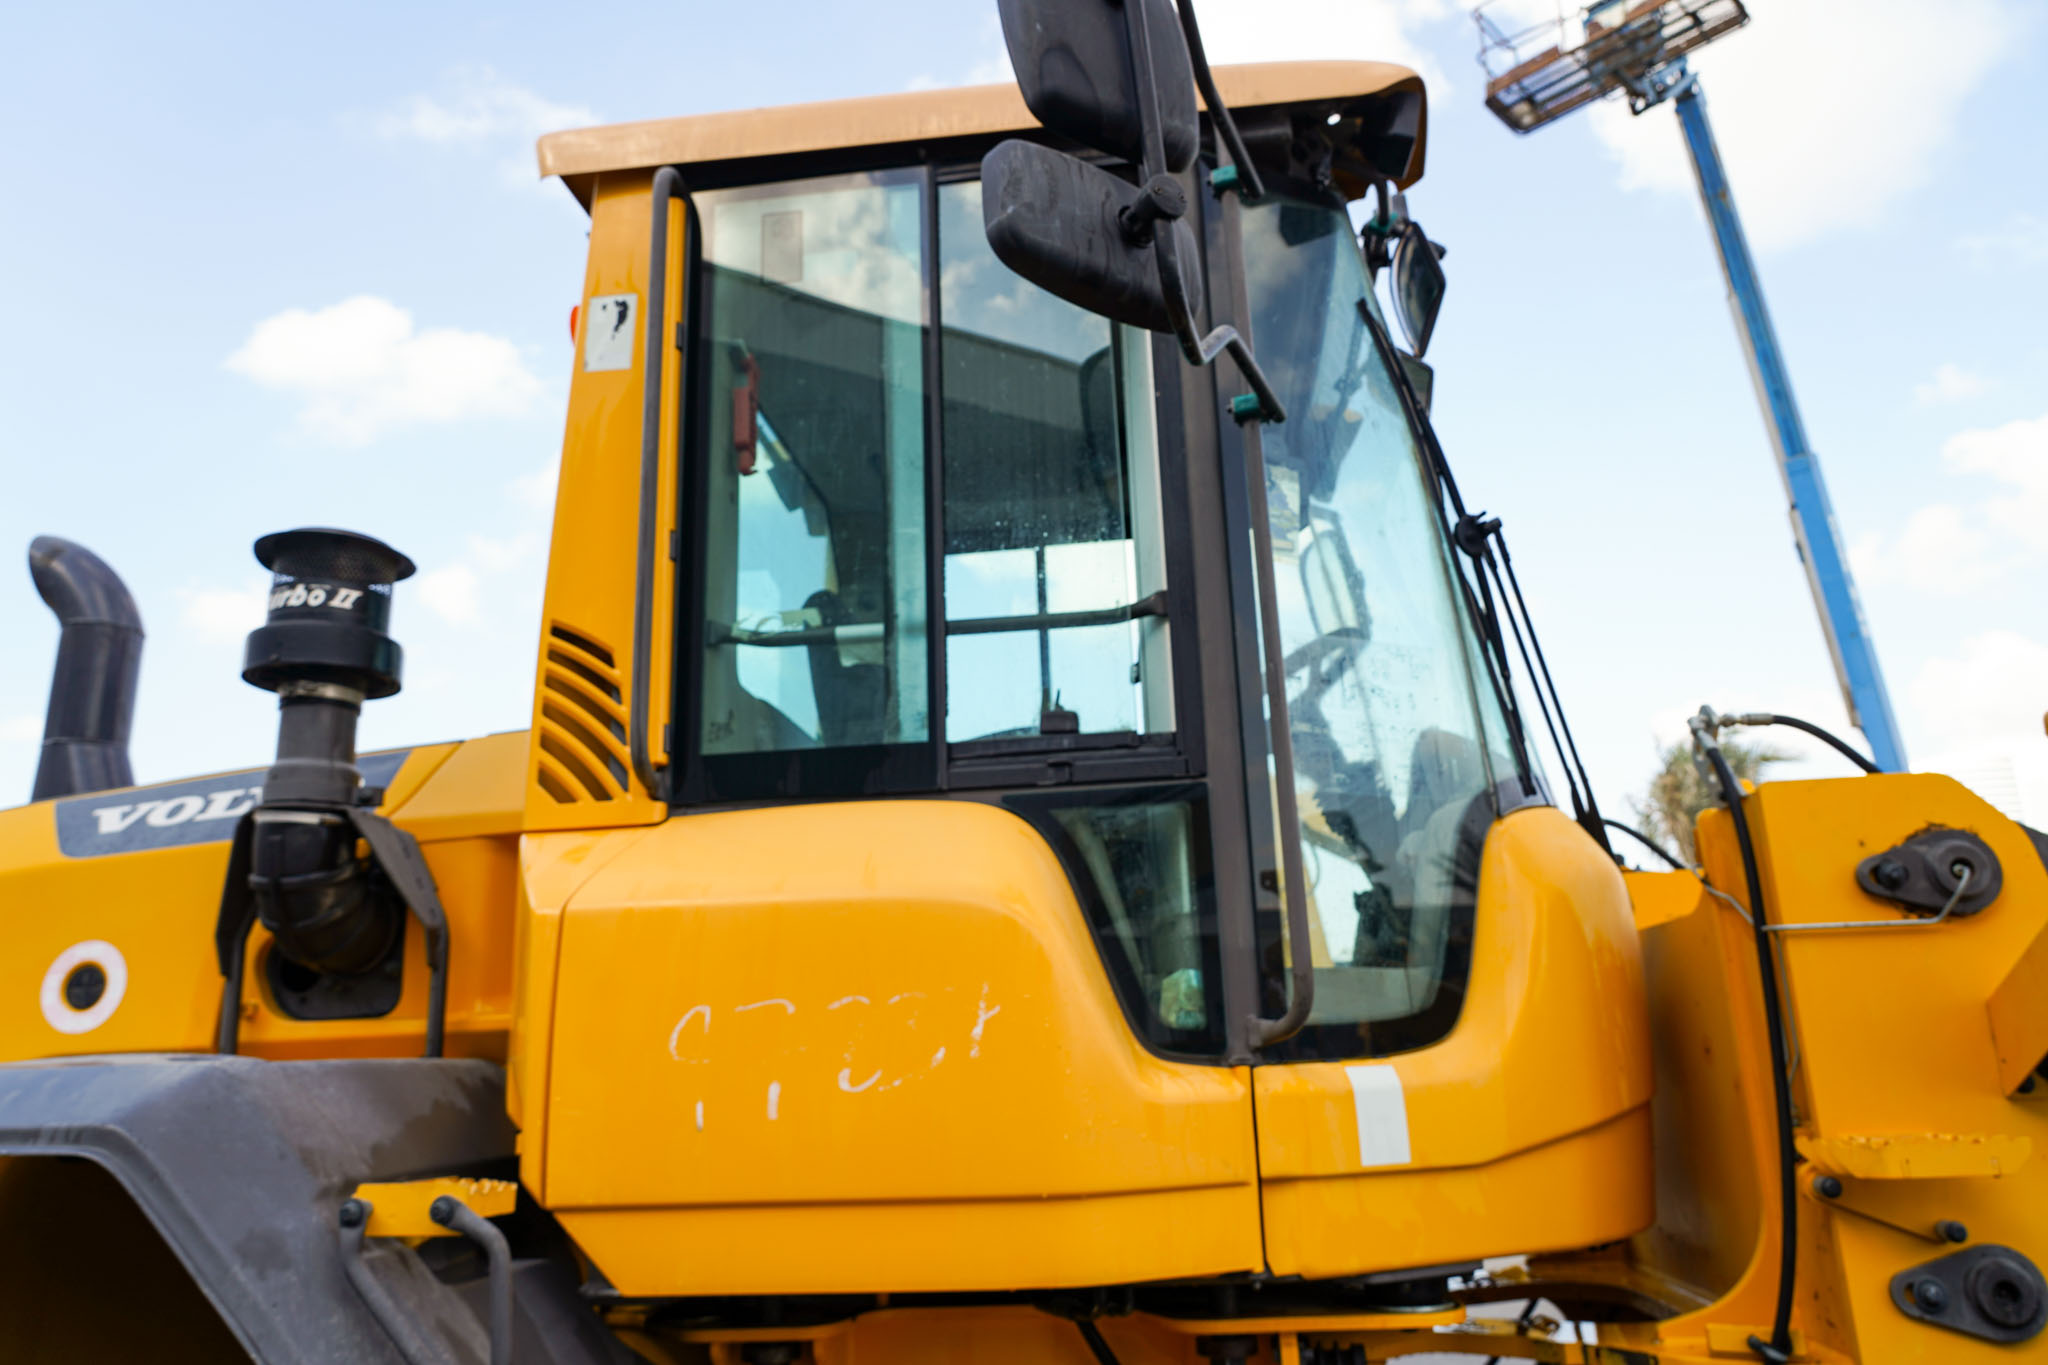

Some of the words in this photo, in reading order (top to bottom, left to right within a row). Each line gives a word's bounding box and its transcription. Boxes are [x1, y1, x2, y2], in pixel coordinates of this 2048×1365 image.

[270, 584, 327, 610] urbo
[328, 587, 363, 610] II
[94, 787, 264, 835] VOL
